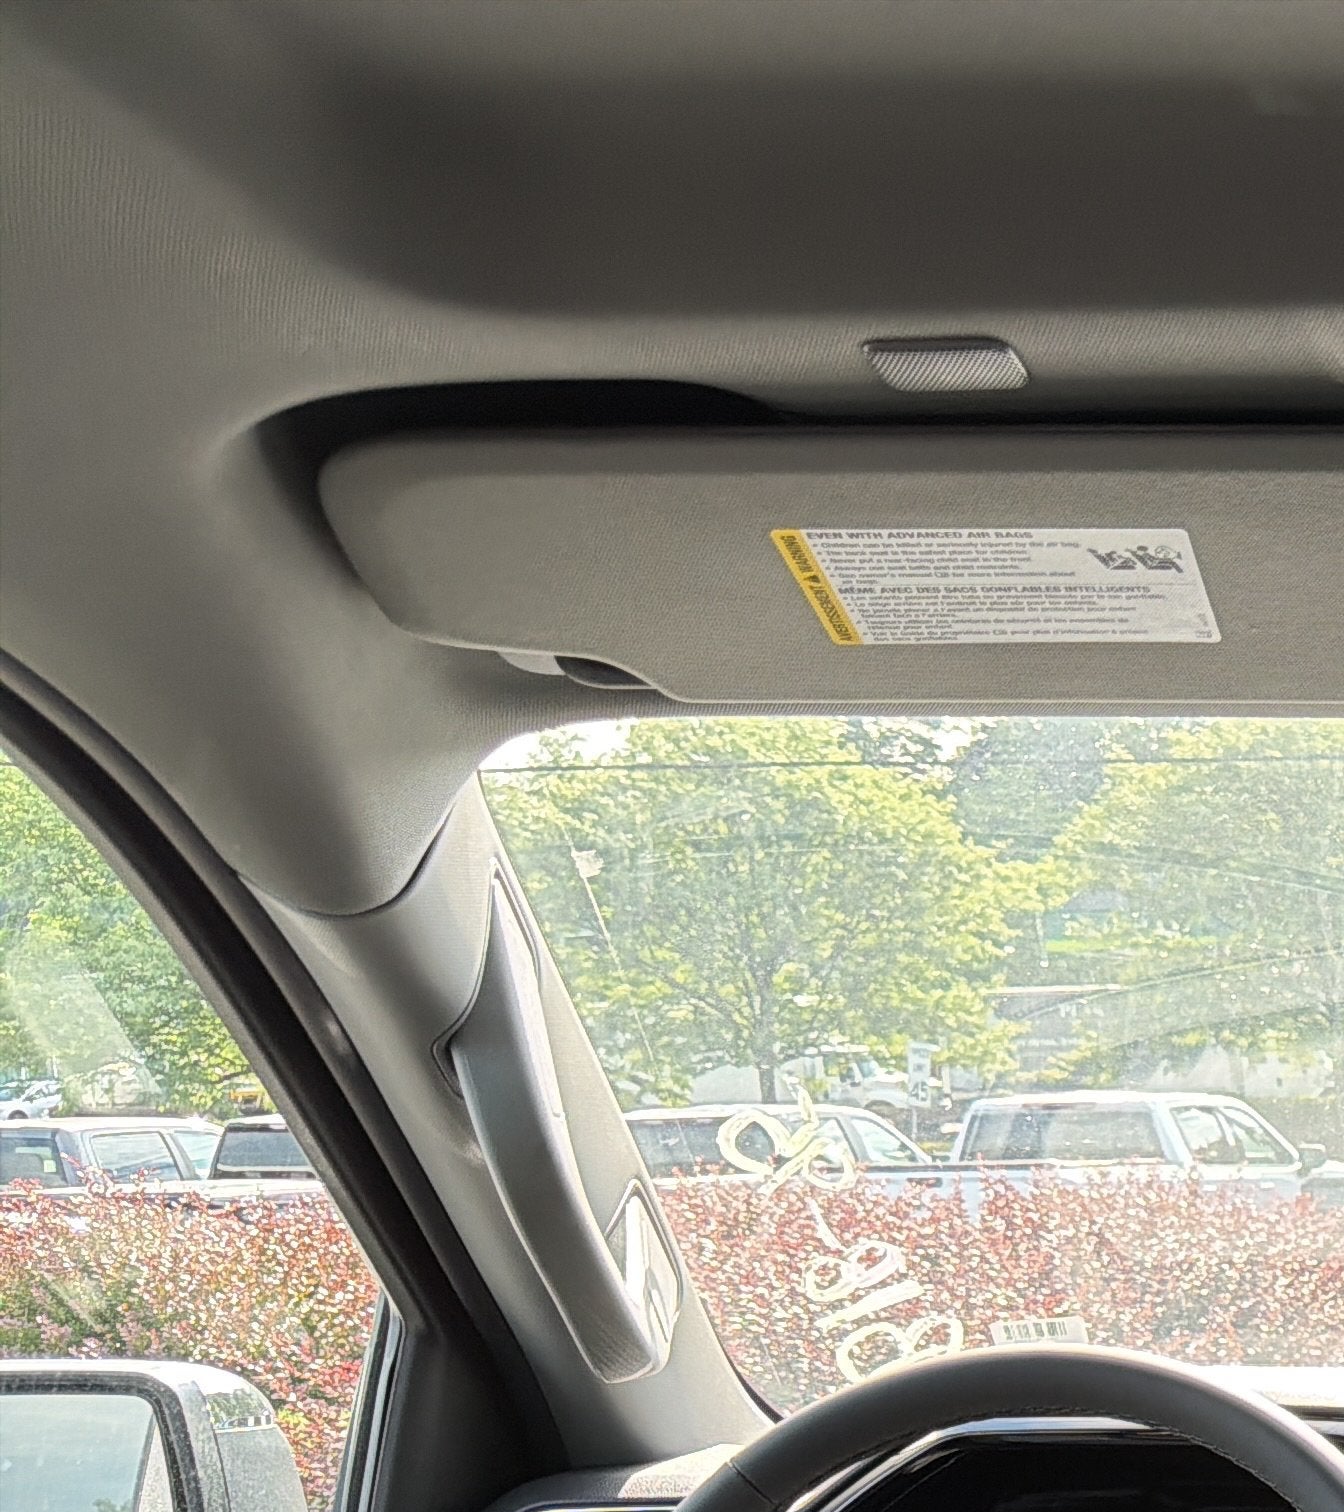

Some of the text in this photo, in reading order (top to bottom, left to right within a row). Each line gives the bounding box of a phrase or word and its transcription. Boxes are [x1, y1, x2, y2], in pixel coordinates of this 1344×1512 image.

[806, 532, 843, 540] EVEN
[780, 535, 812, 573] WARNING
[911, 1081, 929, 1101] 45
